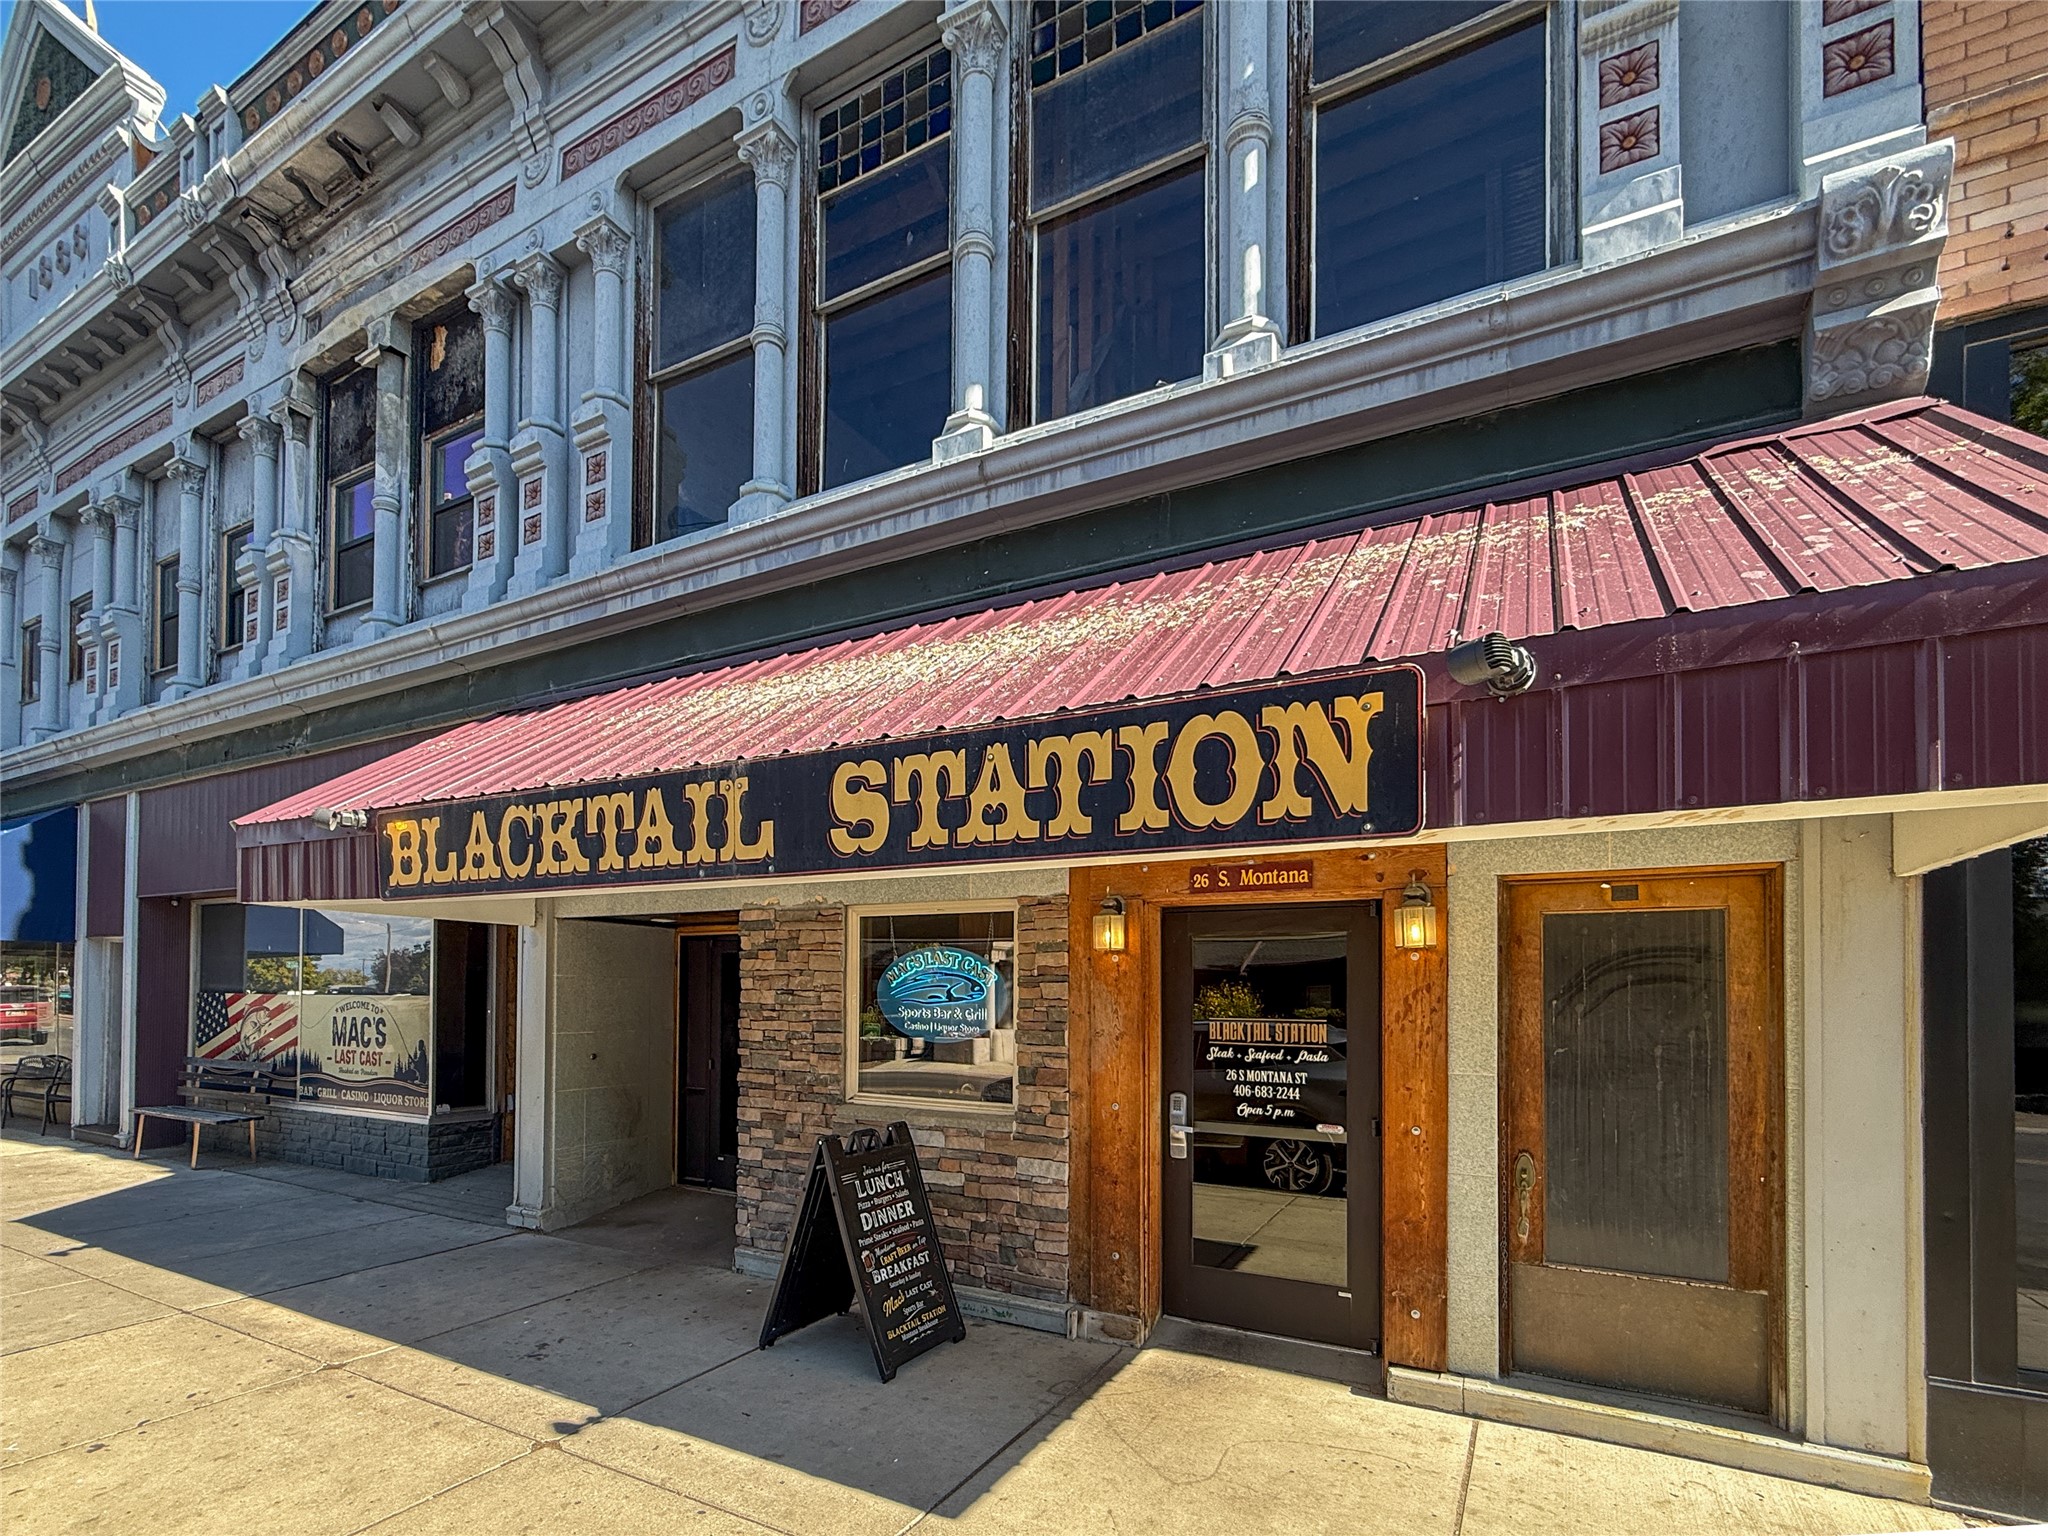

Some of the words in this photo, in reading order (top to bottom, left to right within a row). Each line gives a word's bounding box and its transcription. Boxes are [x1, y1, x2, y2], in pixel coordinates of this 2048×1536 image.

[29, 224, 87, 301] 1888
[387, 776, 775, 888] BLACKTAIL
[829, 691, 1384, 856] STATION
[1193, 873, 1209, 888] 26
[1218, 870, 1231, 887] S.
[1239, 868, 1309, 887] Montana
[886, 954, 925, 987] MAC'S
[924, 950, 962, 969] LAST
[960, 956, 998, 987] CAST
[339, 1000, 370, 1013] WELCOME
[371, 1003, 380, 1014] TO
[898, 1005, 931, 1020] Sports
[933, 1006, 952, 1019] Bar
[953, 1007, 963, 1019] &
[965, 1007, 988, 1020] Grill
[332, 1016, 387, 1049] MAC'S
[904, 1021, 930, 1031] Casino
[1208, 1021, 1272, 1043] BLACKTAIL
[1275, 1022, 1328, 1044] STATION
[334, 1049, 357, 1065] LAST
[359, 1050, 383, 1067] CAST
[1206, 1046, 1235, 1061] Steak
[1244, 1047, 1284, 1064] Seafood
[1293, 1049, 1329, 1064] Pasta
[1225, 1068, 1237, 1081] 26
[1239, 1070, 1245, 1081] S
[1246, 1069, 1293, 1084] MONTANA
[1294, 1072, 1308, 1085] ST
[299, 1085, 313, 1096] BAR
[317, 1087, 337, 1099] GRILL
[341, 1089, 369, 1102] CASINO
[373, 1092, 403, 1106] LIQUOR
[1232, 1084, 1300, 1100] 406-683-2244
[1236, 1102, 1264, 1118] Open
[1264, 1104, 1274, 1115] 5
[855, 1170, 905, 1198] LUNCH
[857, 1200, 872, 1211] Pizza
[873, 1194, 893, 1206] Burgers
[894, 1188, 910, 1199] Salads
[860, 1200, 915, 1231] DINNER
[858, 1236, 874, 1247] Prime
[873, 1230, 890, 1242] Steaks
[891, 1222, 911, 1235] Seafood
[911, 1218, 925, 1228] Pasta
[871, 1250, 930, 1284] BREAKFAST
[904, 1286, 919, 1298] LAST
[919, 1280, 933, 1291] CAST
[902, 1303, 917, 1316] Sports
[886, 1317, 922, 1340] BLACKTAIL
[921, 1304, 947, 1322] STATION
